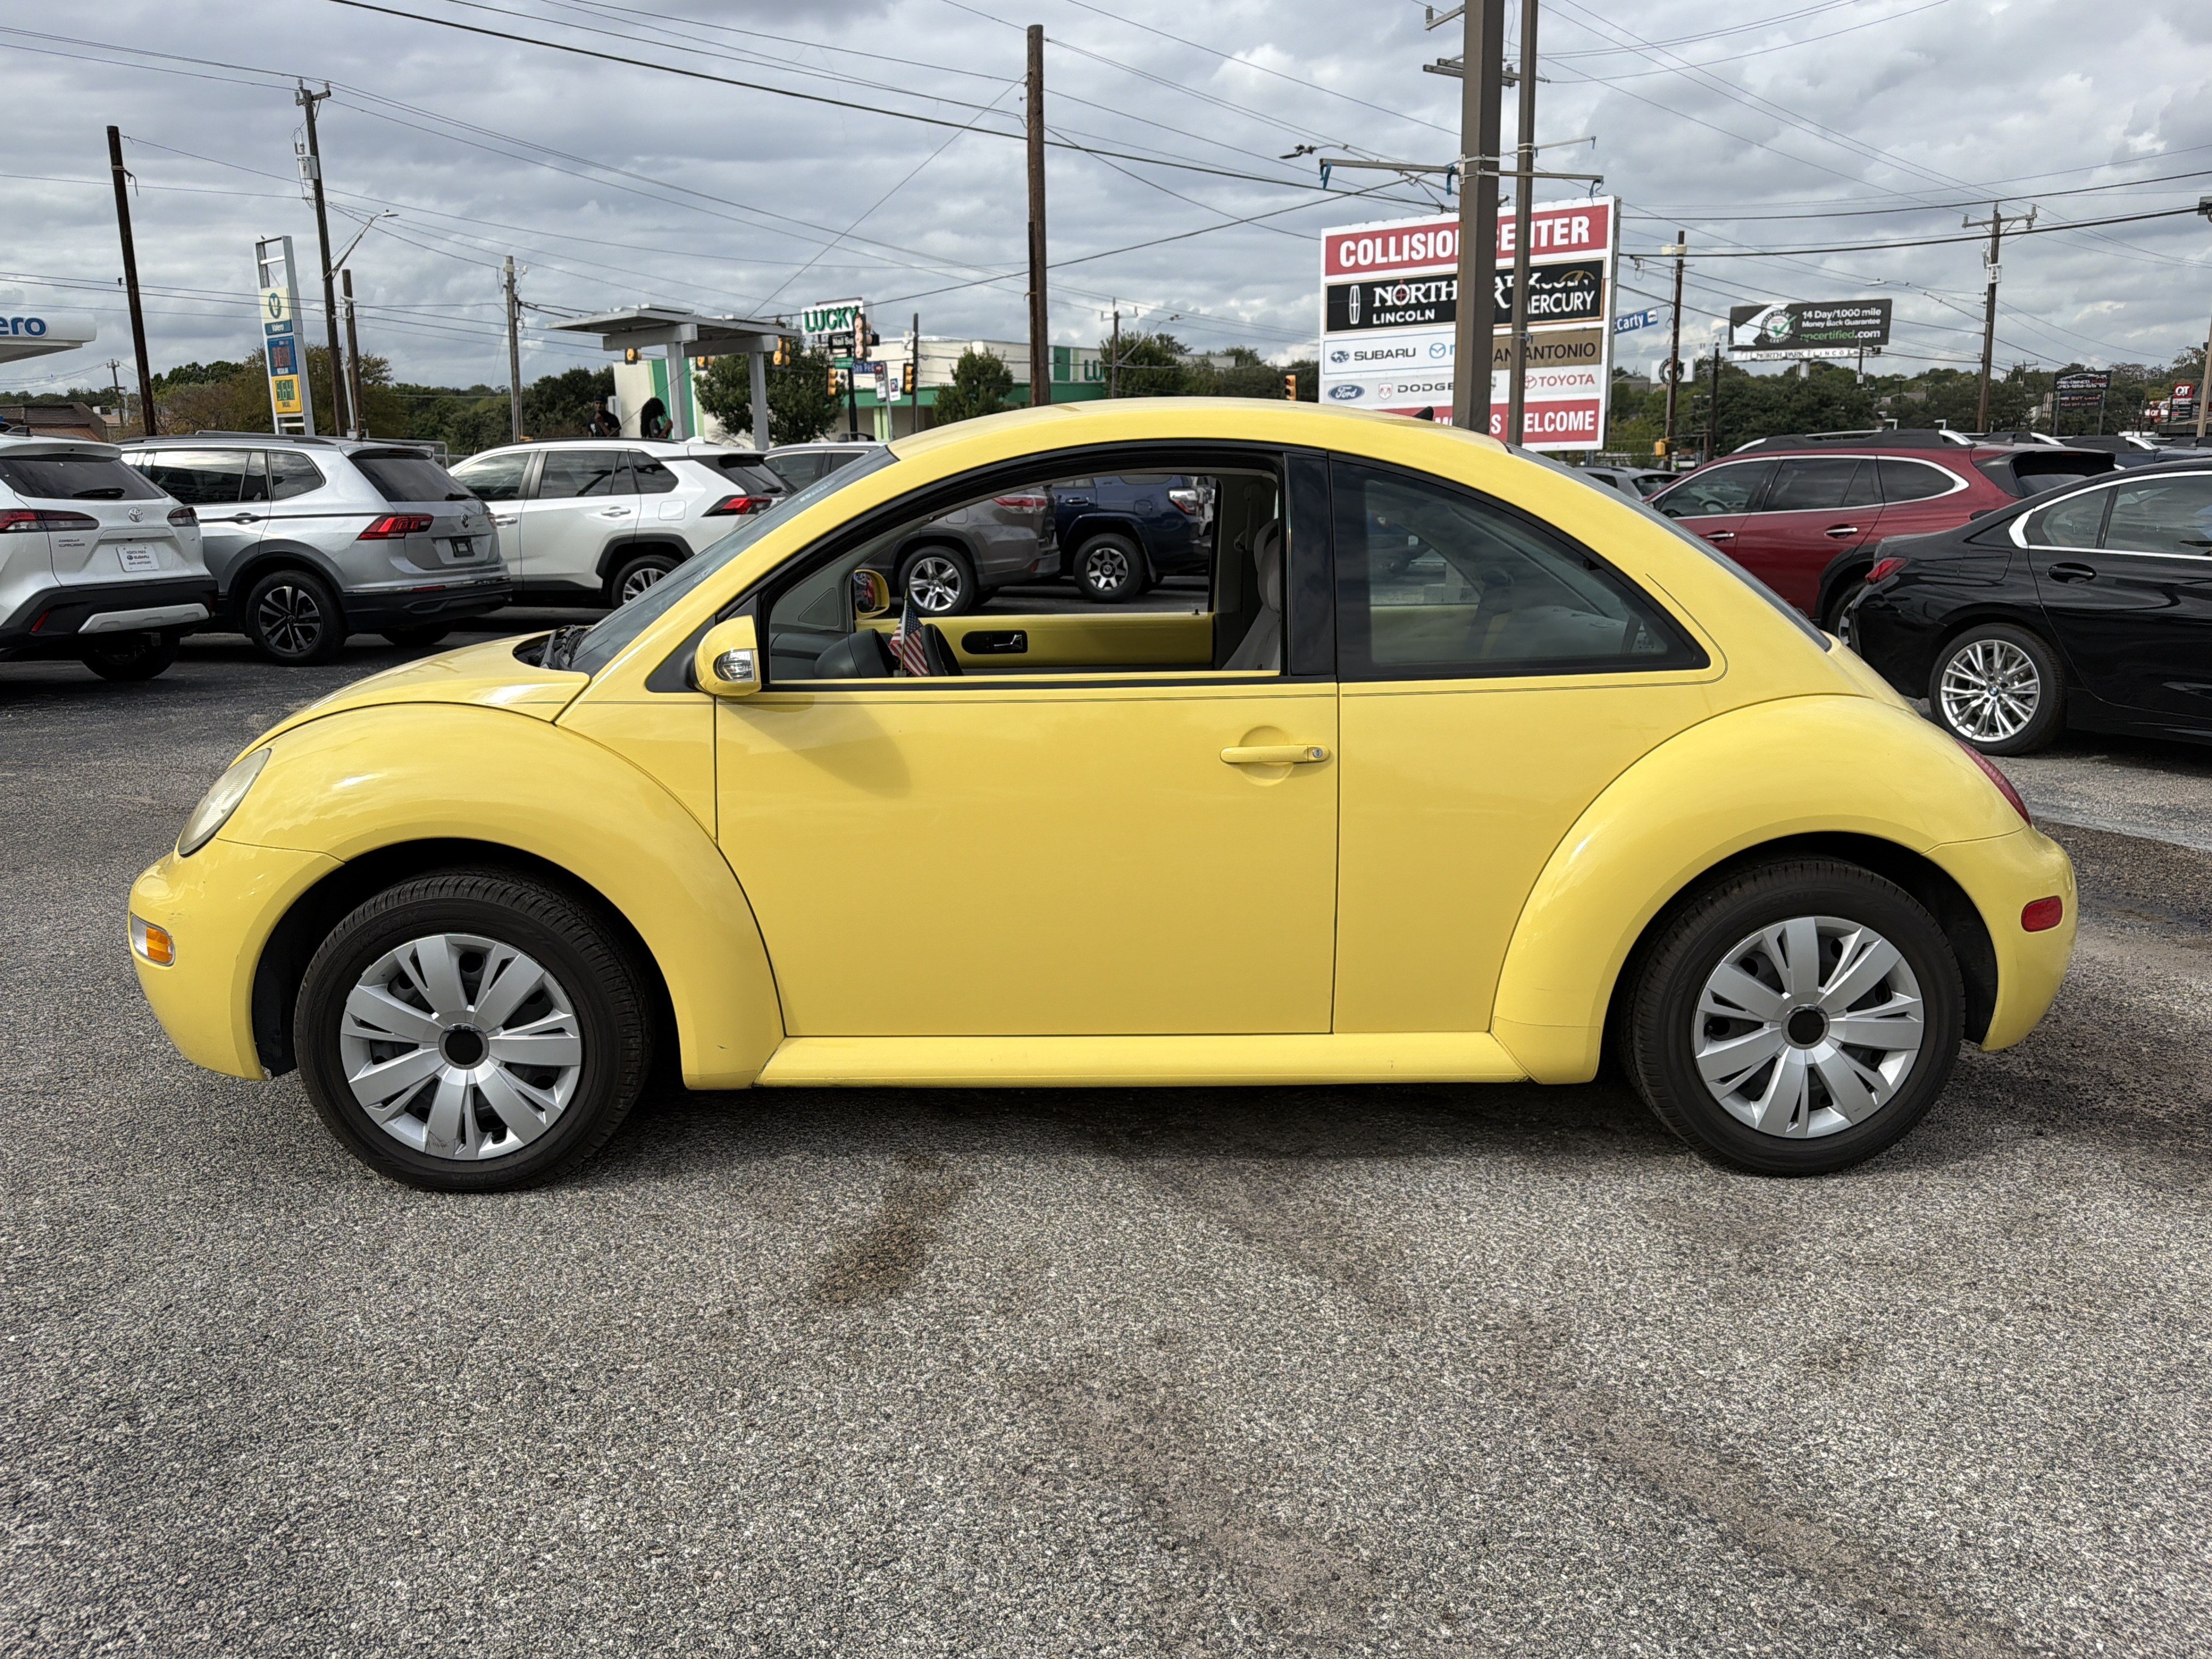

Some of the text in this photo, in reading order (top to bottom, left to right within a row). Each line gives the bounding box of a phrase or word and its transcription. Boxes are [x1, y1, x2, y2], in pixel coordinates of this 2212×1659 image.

[1339, 216, 1590, 268] COLLISIO ETER
[1373, 280, 1458, 307] NORTH
[1527, 291, 1595, 315] ERCURY
[804, 306, 859, 332] LUCKY
[1373, 309, 1435, 324] LINCOLN
[1802, 311, 1813, 319] 14
[1861, 307, 1882, 317] mile
[1826, 319, 1843, 328] Back
[1354, 347, 1417, 361] SUBARU
[1526, 342, 1596, 360] ANTONIO
[1539, 374, 1595, 387] TOYOTA
[1335, 386, 1357, 398] Ford
[2175, 386, 2190, 396] QT
[1523, 410, 1595, 433] ELCOME
